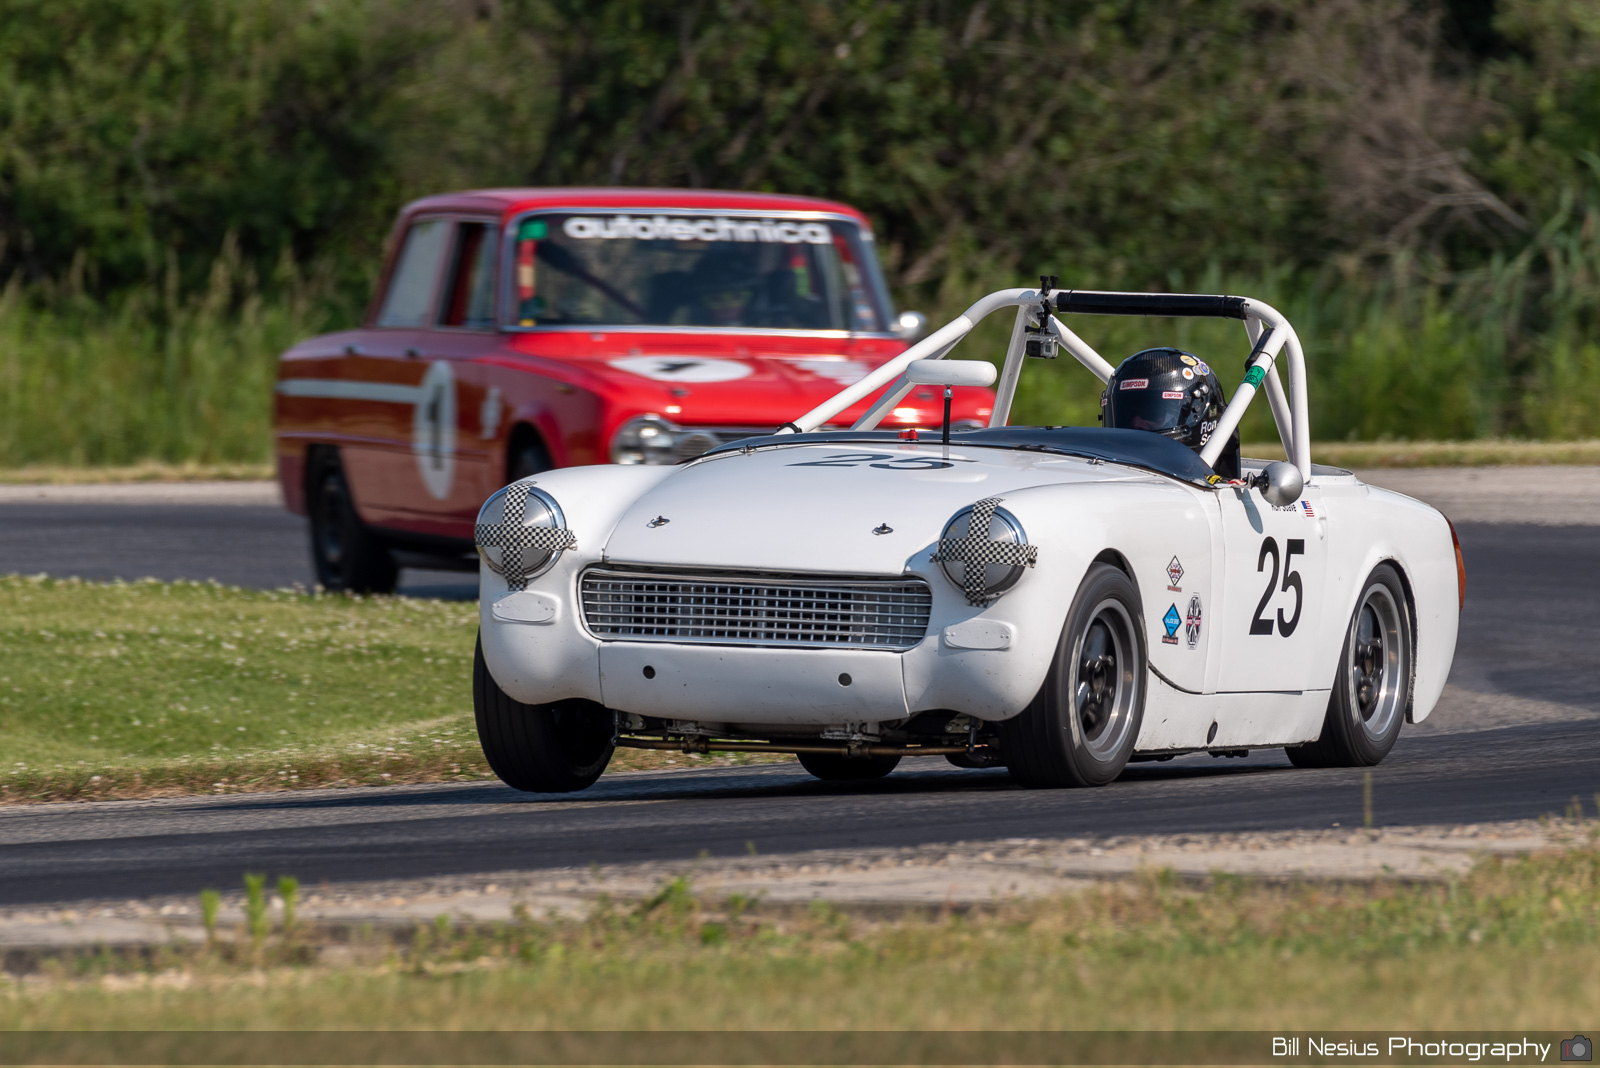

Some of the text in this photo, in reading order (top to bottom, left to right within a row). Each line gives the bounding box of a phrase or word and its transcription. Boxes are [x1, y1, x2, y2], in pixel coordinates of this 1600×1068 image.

[563, 215, 832, 244] autotechnica
[1121, 379, 1146, 388] SIMPSON
[784, 453, 980, 470] 25
[1249, 535, 1305, 638] 25
